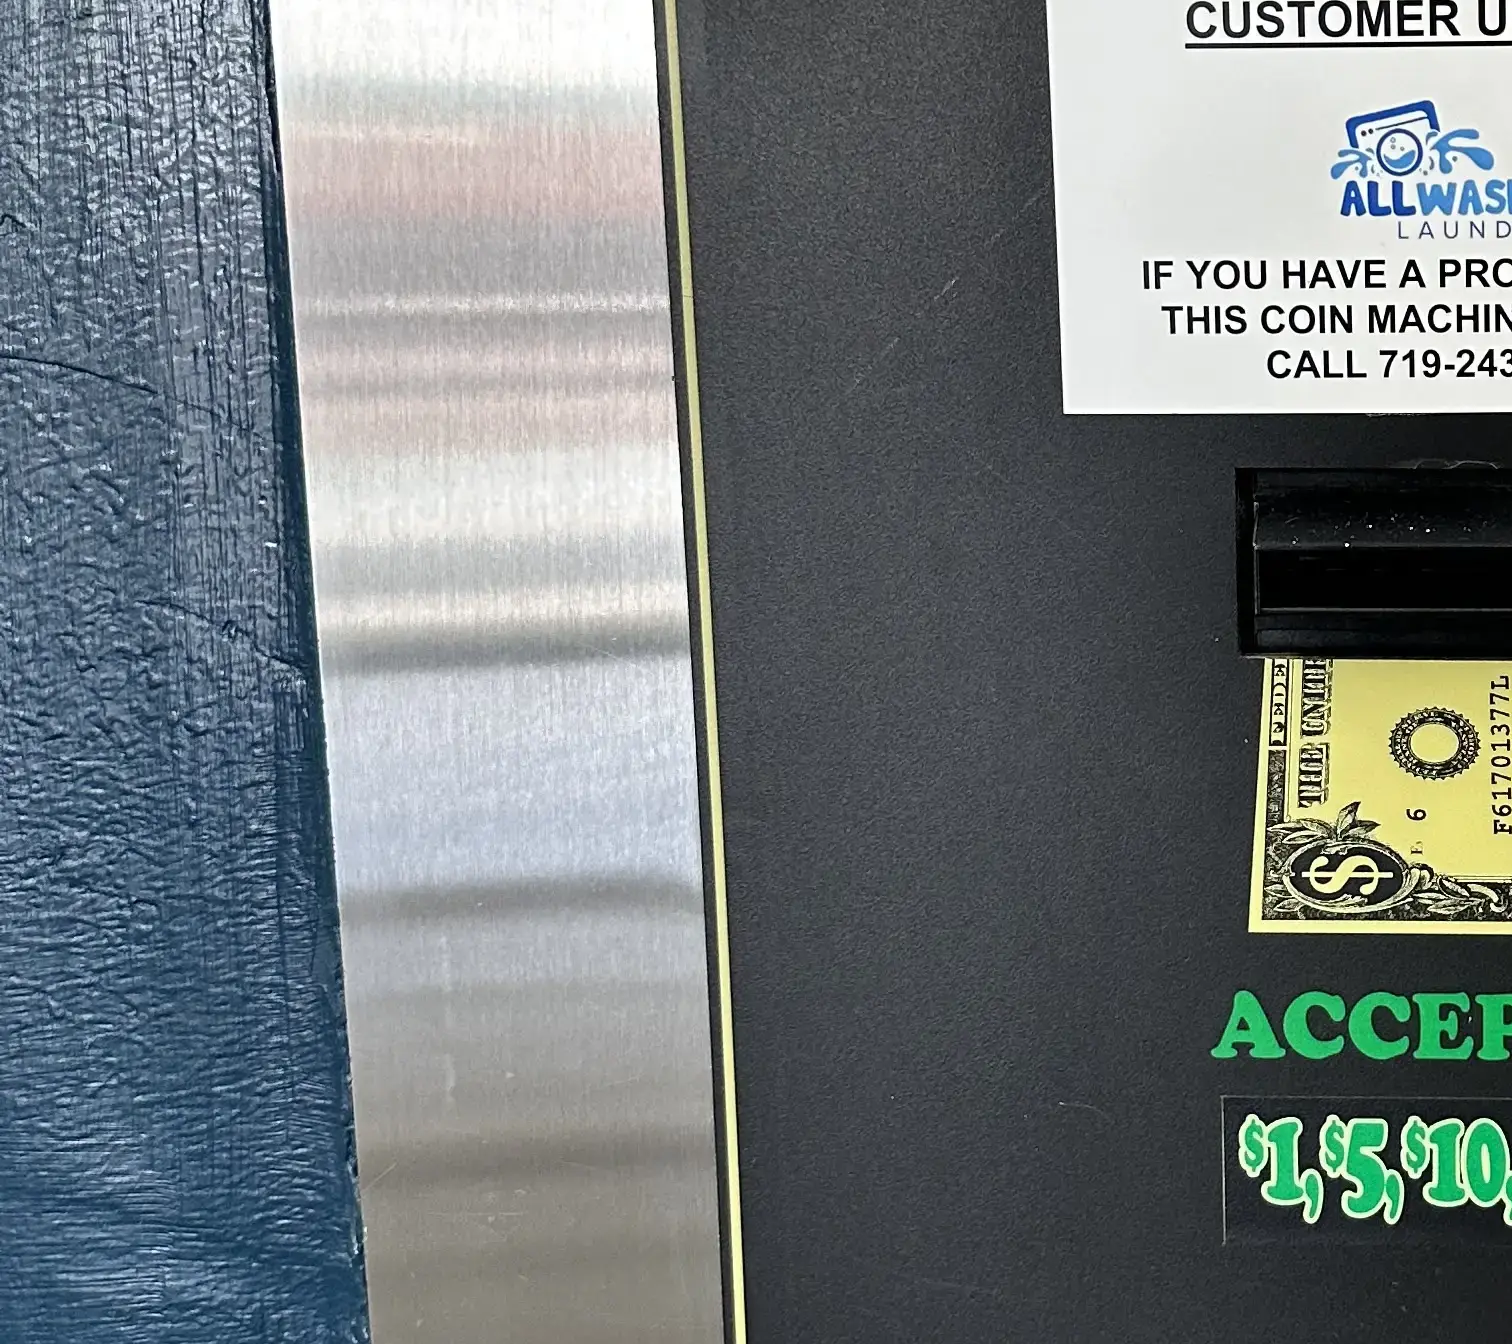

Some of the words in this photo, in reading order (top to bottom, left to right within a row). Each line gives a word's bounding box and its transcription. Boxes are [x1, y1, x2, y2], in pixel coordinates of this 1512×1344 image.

[1186, 0, 1461, 39] CUSTOMER
[1142, 260, 1174, 290] IF
[1185, 259, 1267, 290] YOU
[1282, 259, 1387, 289] HAVE
[1398, 259, 1427, 289] A
[1160, 305, 1248, 335] THIS
[1260, 304, 1353, 335] COIN
[1266, 349, 1368, 379] CALL
[1488, 674, 1512, 836] F61701377L
[1297, 743, 1329, 808] THE
[1406, 808, 1427, 821] 6
